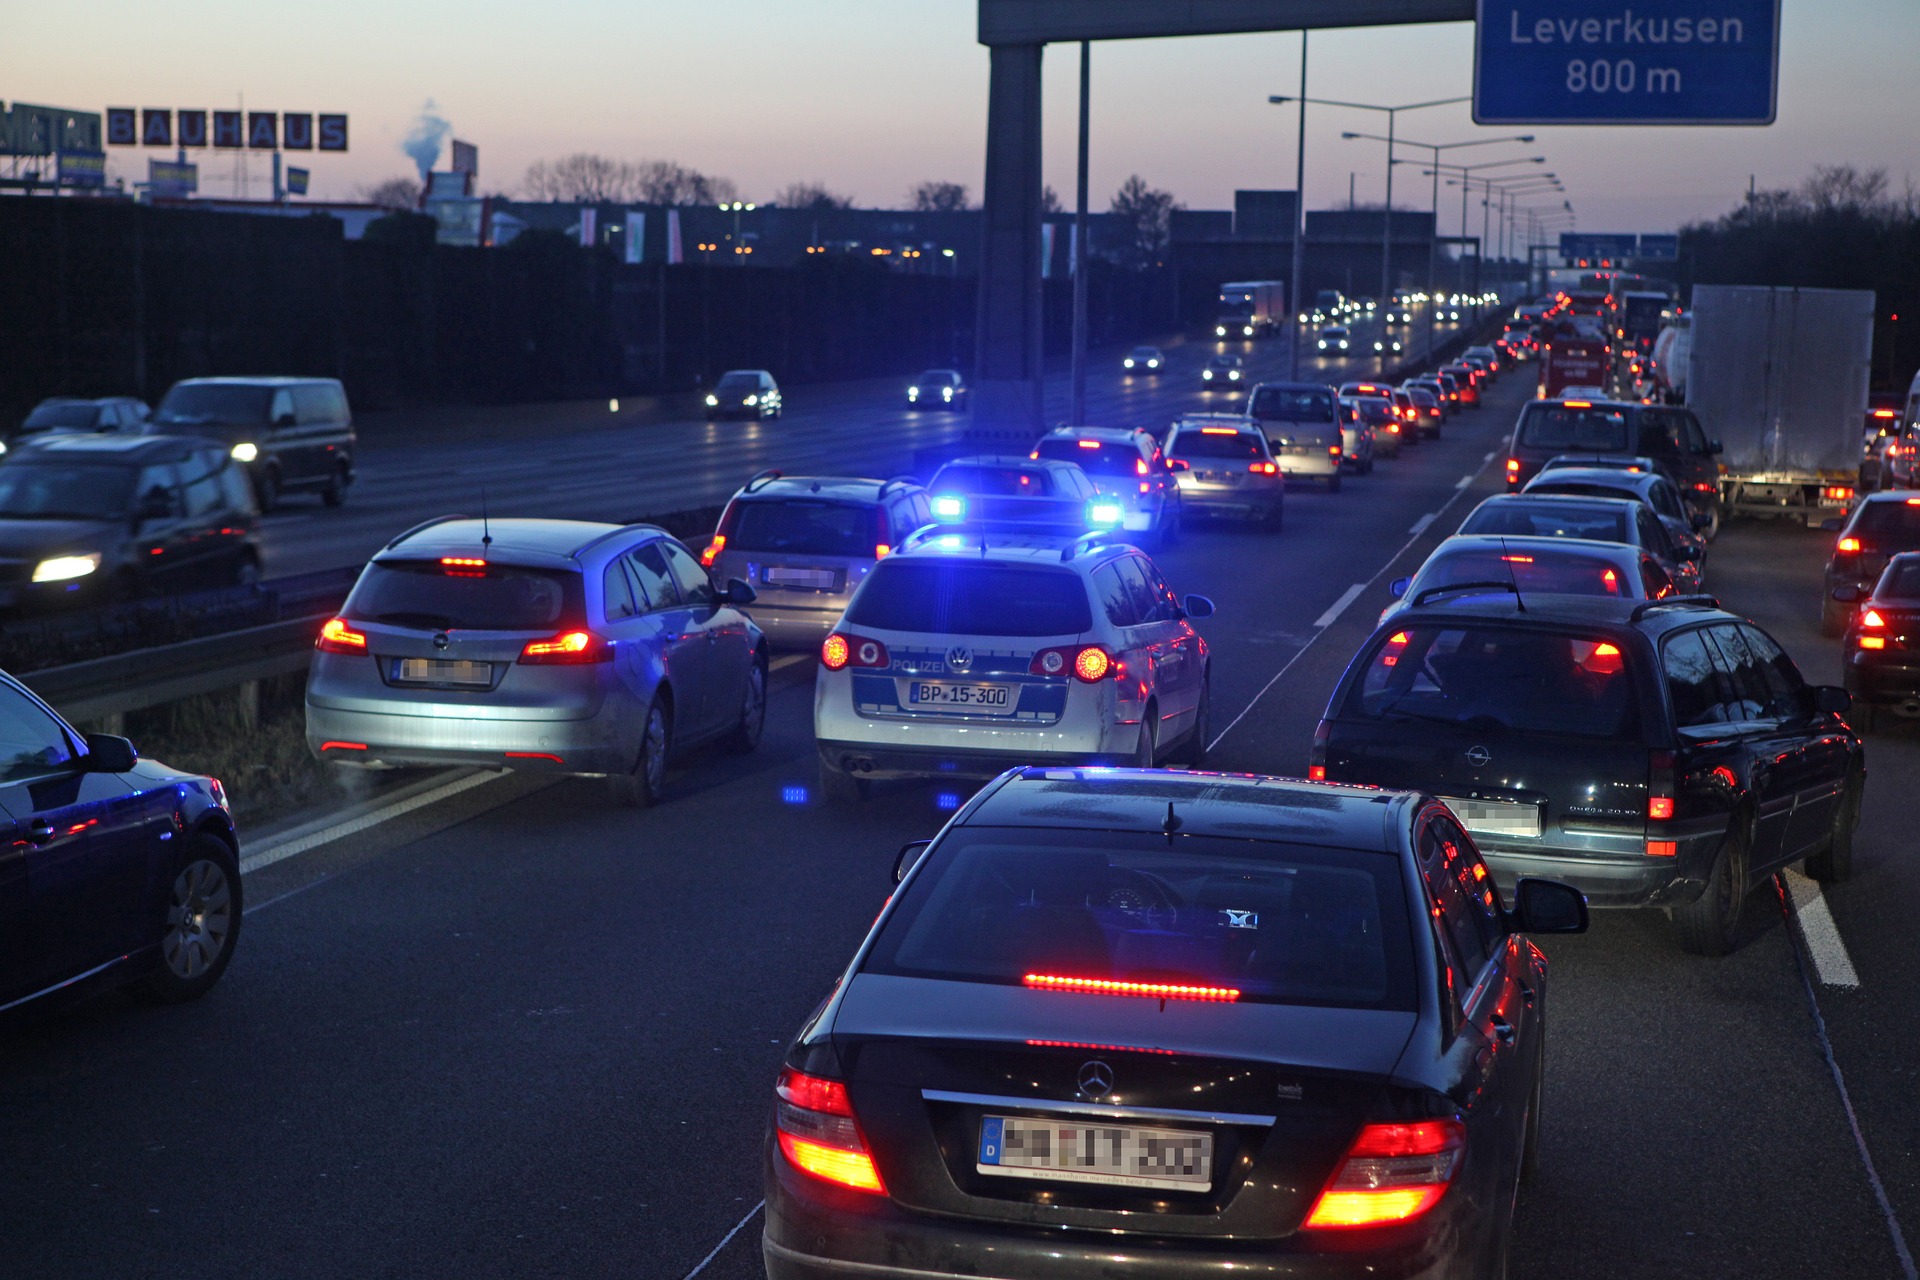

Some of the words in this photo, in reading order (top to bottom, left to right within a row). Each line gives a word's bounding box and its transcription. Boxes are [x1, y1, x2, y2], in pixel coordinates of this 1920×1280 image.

[1510, 10, 1743, 43] Leverkusen
[1566, 59, 1635, 93] 800
[1647, 67, 1681, 93] m
[108, 109, 347, 150] BAUHAUS
[892, 659, 945, 673] POLIZEI
[920, 685, 941, 701] BP
[950, 687, 1006, 704] 15-300
[987, 1145, 995, 1157] D
